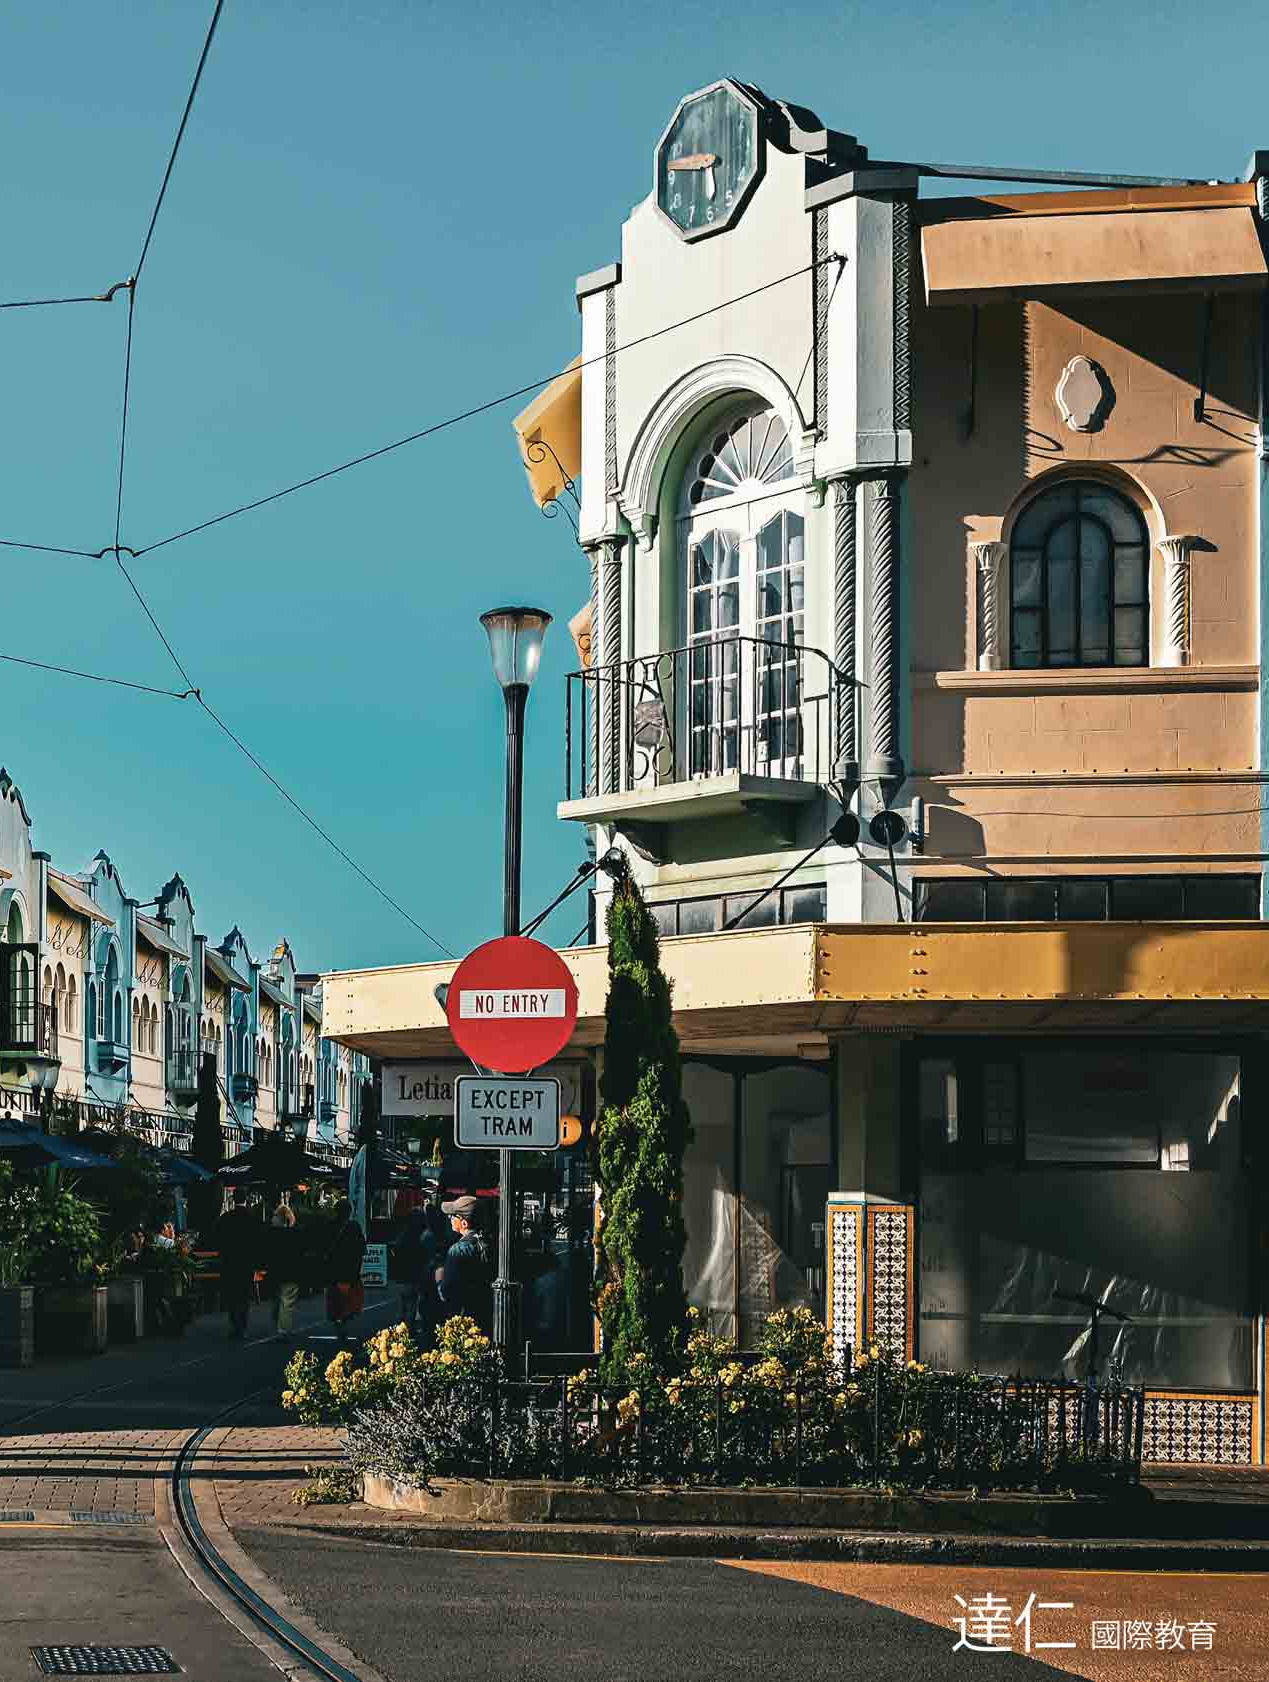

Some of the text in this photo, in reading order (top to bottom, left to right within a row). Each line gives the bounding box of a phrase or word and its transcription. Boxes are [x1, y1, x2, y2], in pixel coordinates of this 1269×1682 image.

[475, 994, 549, 1013] NO ENTRY
[397, 1072, 454, 1101] Letia
[470, 1089, 545, 1110] EXCEPT
[480, 1116, 533, 1137] TRAM
